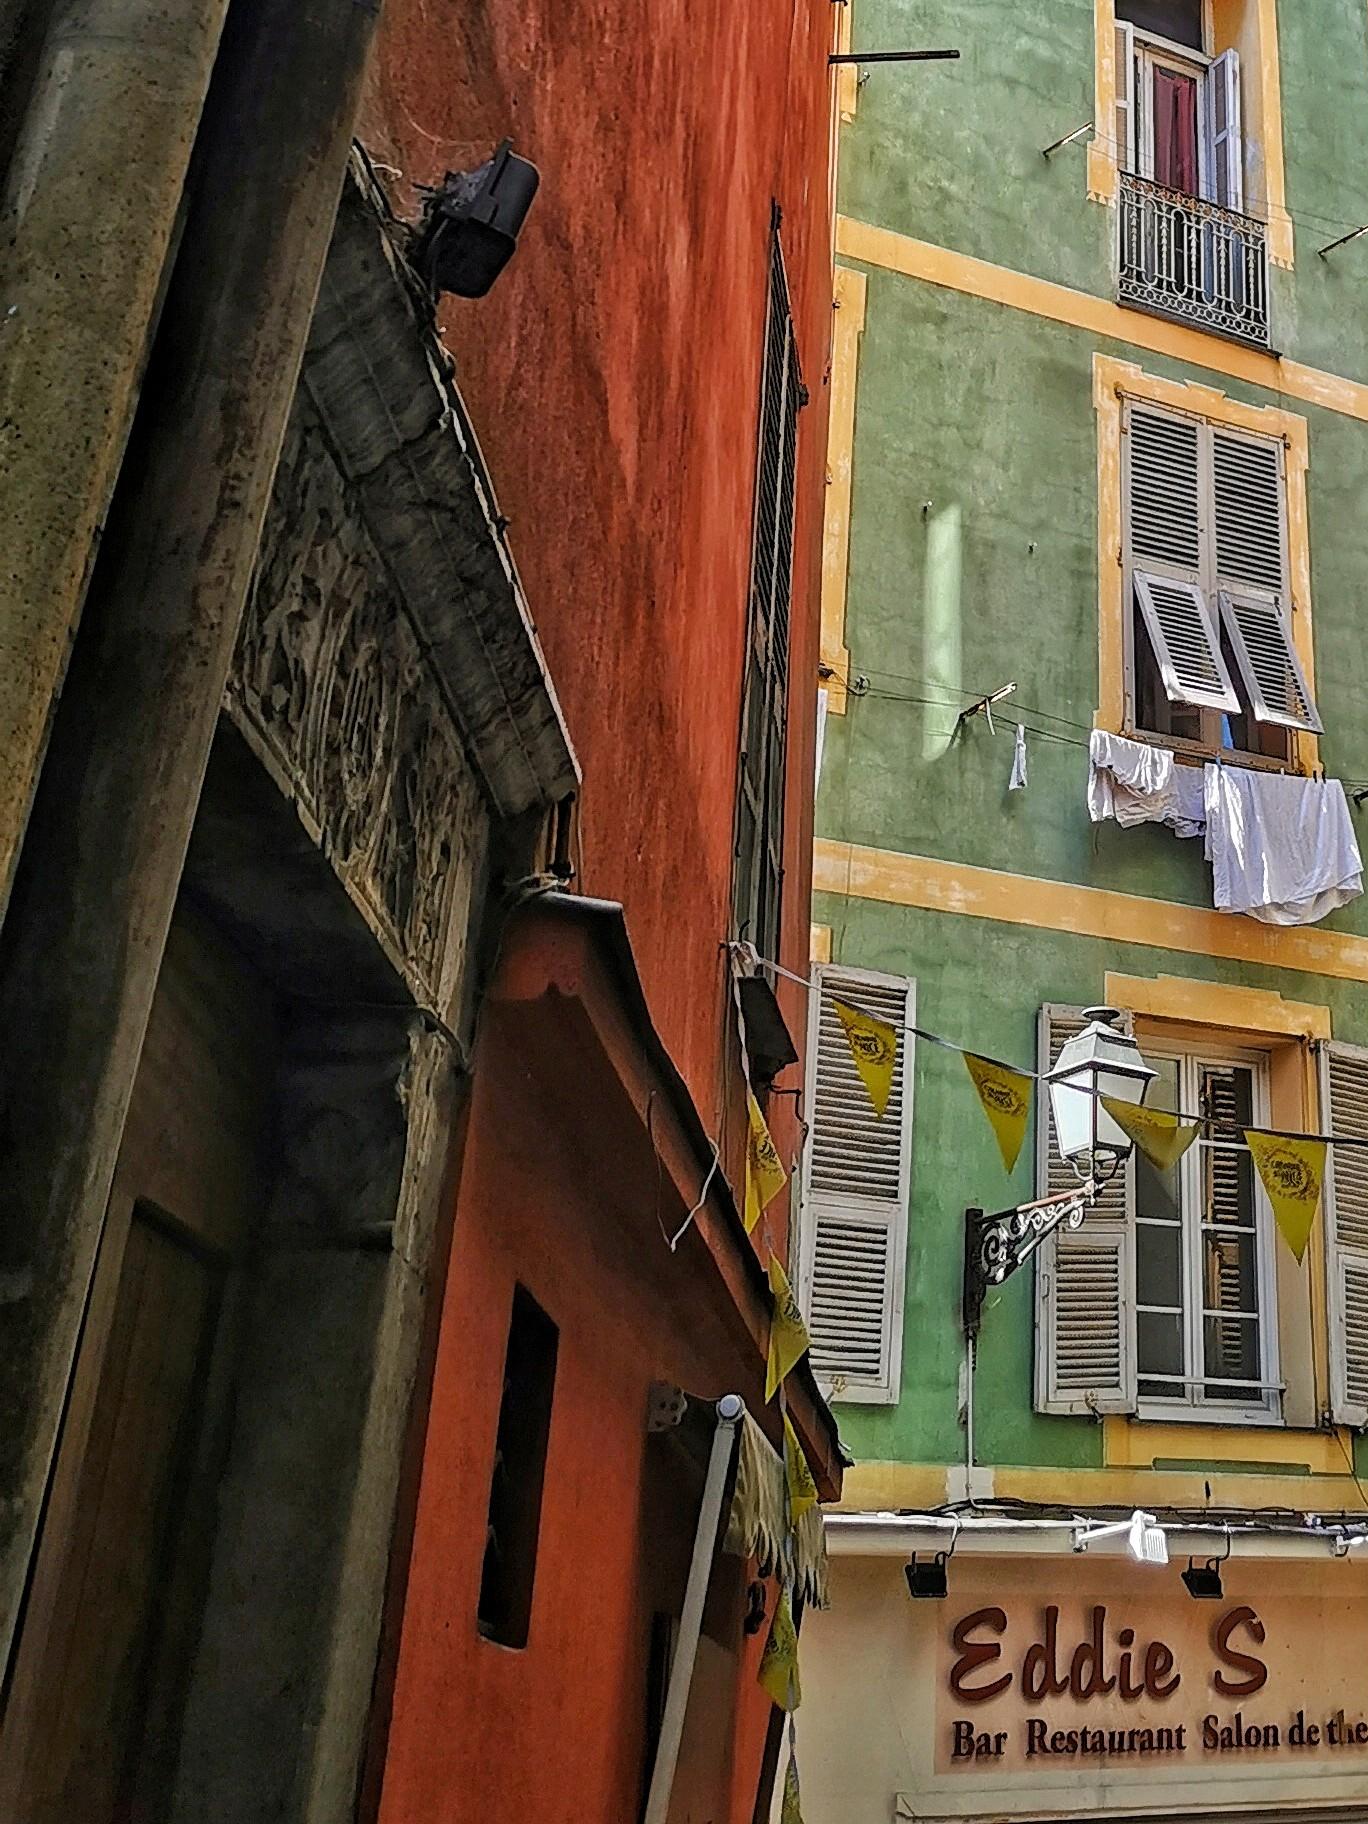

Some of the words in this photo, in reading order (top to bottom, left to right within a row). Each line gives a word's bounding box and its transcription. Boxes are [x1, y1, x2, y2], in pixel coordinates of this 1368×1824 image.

[950, 1605, 1180, 1700] Eddie
[1214, 1606, 1268, 1695] S
[951, 1720, 1008, 1757] Bar
[1025, 1718, 1187, 1756] Restaurant
[1202, 1711, 1280, 1749] Salon
[1288, 1709, 1320, 1746] de
